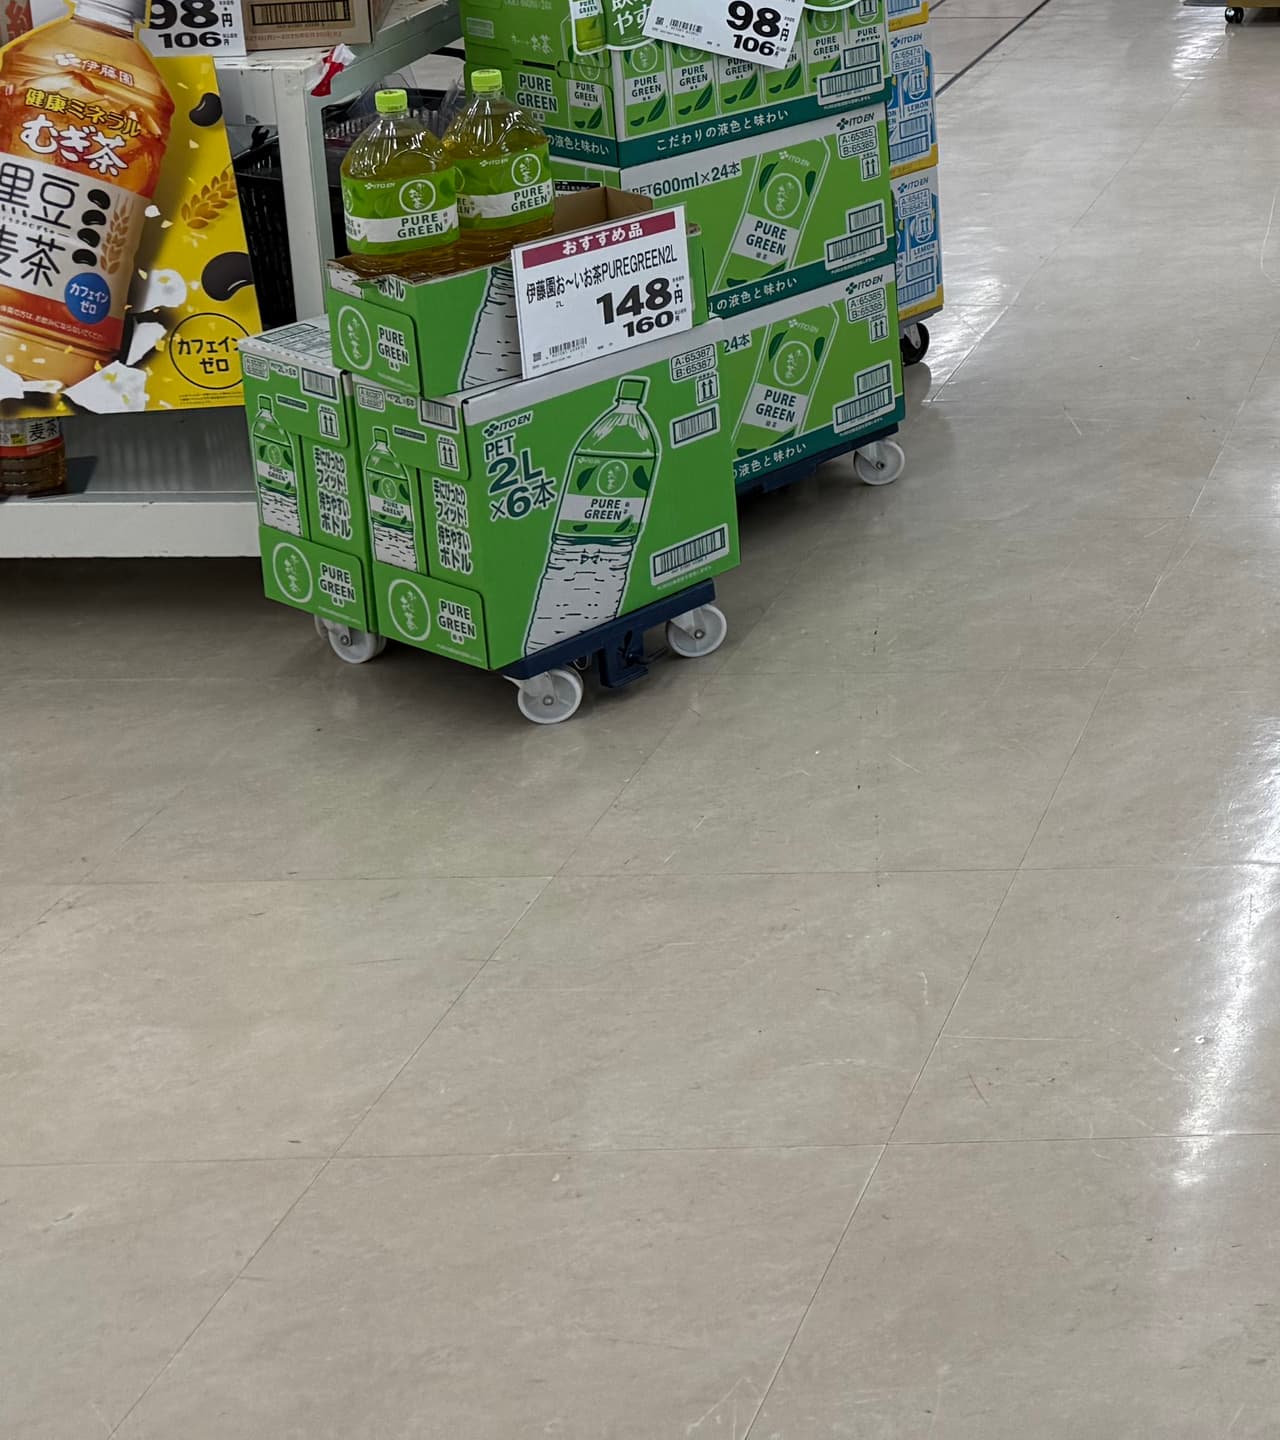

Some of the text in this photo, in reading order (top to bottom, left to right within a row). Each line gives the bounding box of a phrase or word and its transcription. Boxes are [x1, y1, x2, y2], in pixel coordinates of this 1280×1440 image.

[726, 1, 781, 38] 98
[158, 32, 222, 48] 106
[733, 34, 775, 56] 106
[81, 59, 134, 87] 伊藤園
[520, 74, 552, 92] PURE
[25, 88, 141, 137] 健康ミネラル
[517, 93, 557, 111] GREEN
[656, 110, 790, 151] こだわりの液色と味わい
[19, 115, 128, 176] むぎ茶
[397, 223, 443, 239] GREEN
[401, 214, 438, 227] PURE
[754, 220, 788, 241] PURE
[562, 223, 643, 256] おすすめ品
[745, 233, 786, 257] GREEN
[69, 283, 109, 302] カフェイン
[596, 277, 673, 325] 148
[80, 299, 97, 315] ゼロ
[623, 310, 674, 337] 160
[177, 337, 239, 353] カフェイン
[379, 327, 404, 346] PURE
[199, 357, 230, 374] ゼロ
[674, 347, 711, 366] A:65387
[676, 359, 712, 378] B:65387
[763, 389, 796, 408] PURE
[755, 403, 796, 423] GREEN
[485, 435, 515, 460] PET
[489, 449, 543, 493] 2L
[321, 514, 351, 538] ボトル
[440, 548, 471, 573] ボトル
[322, 565, 351, 584] PURE
[320, 578, 355, 601] GREEN
[440, 600, 471, 620] PURE
[438, 614, 475, 637] GREEN
